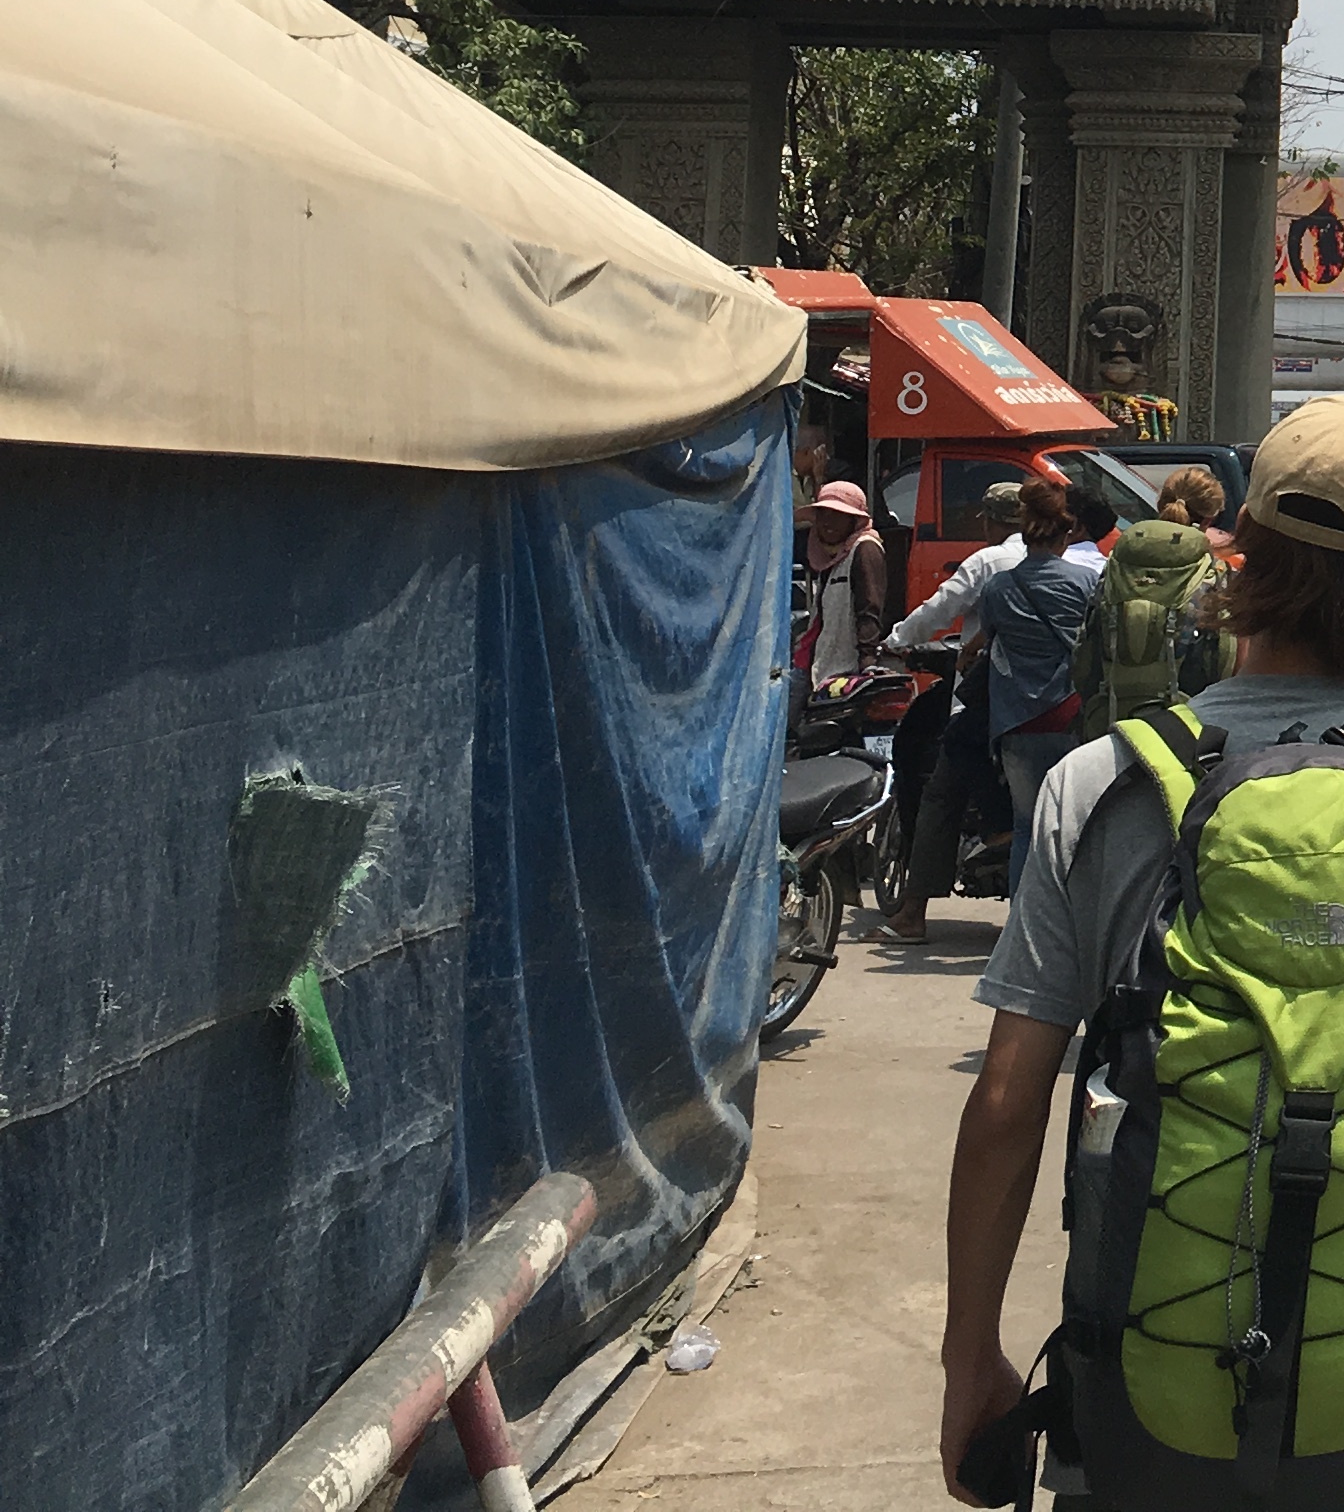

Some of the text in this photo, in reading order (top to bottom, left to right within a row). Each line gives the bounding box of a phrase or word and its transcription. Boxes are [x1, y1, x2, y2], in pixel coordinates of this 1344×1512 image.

[897, 371, 928, 415] 8
[1293, 901, 1328, 917] THE
[1265, 917, 1328, 933] NORTH
[1282, 931, 1329, 948] FACE
